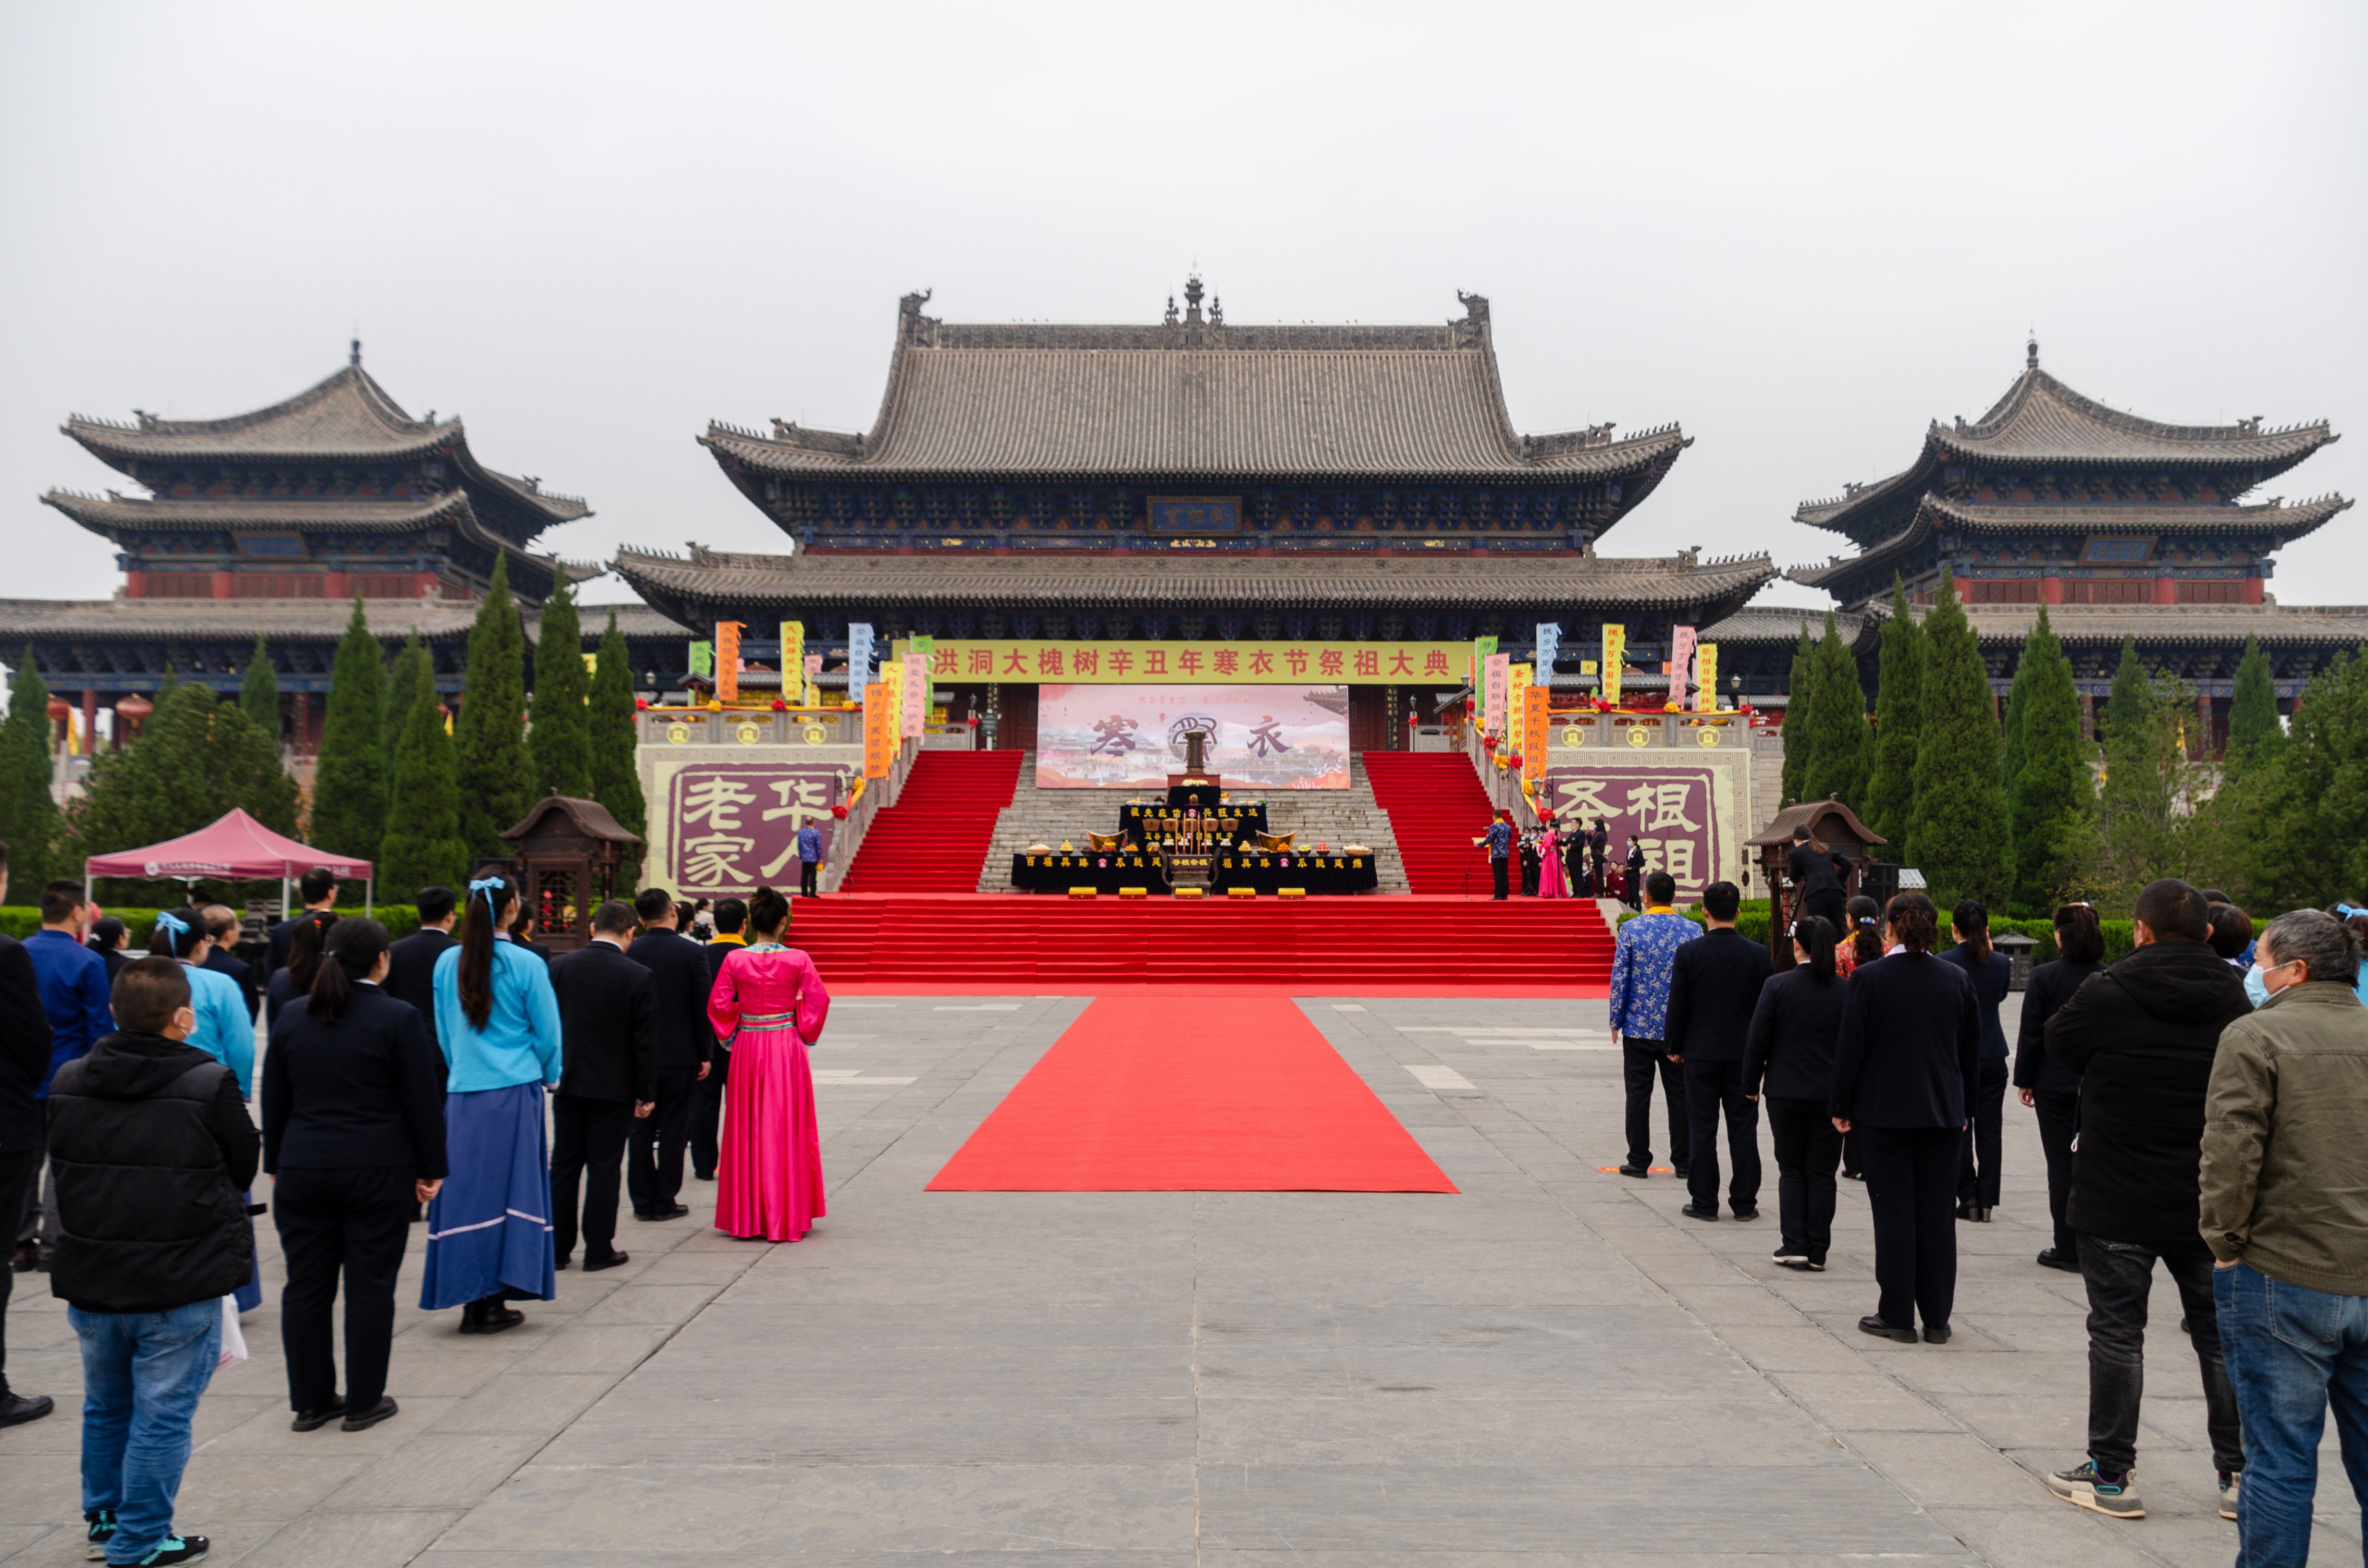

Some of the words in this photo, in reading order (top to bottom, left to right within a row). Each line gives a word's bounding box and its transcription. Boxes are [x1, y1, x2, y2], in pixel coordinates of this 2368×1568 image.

[933, 647, 1450, 676] 洪洞大槐树辛丑年寒衣节祭祖大典
[1203, 808, 1258, 818] 兴旺发达
[1210, 858, 1270, 869] 福具臻
